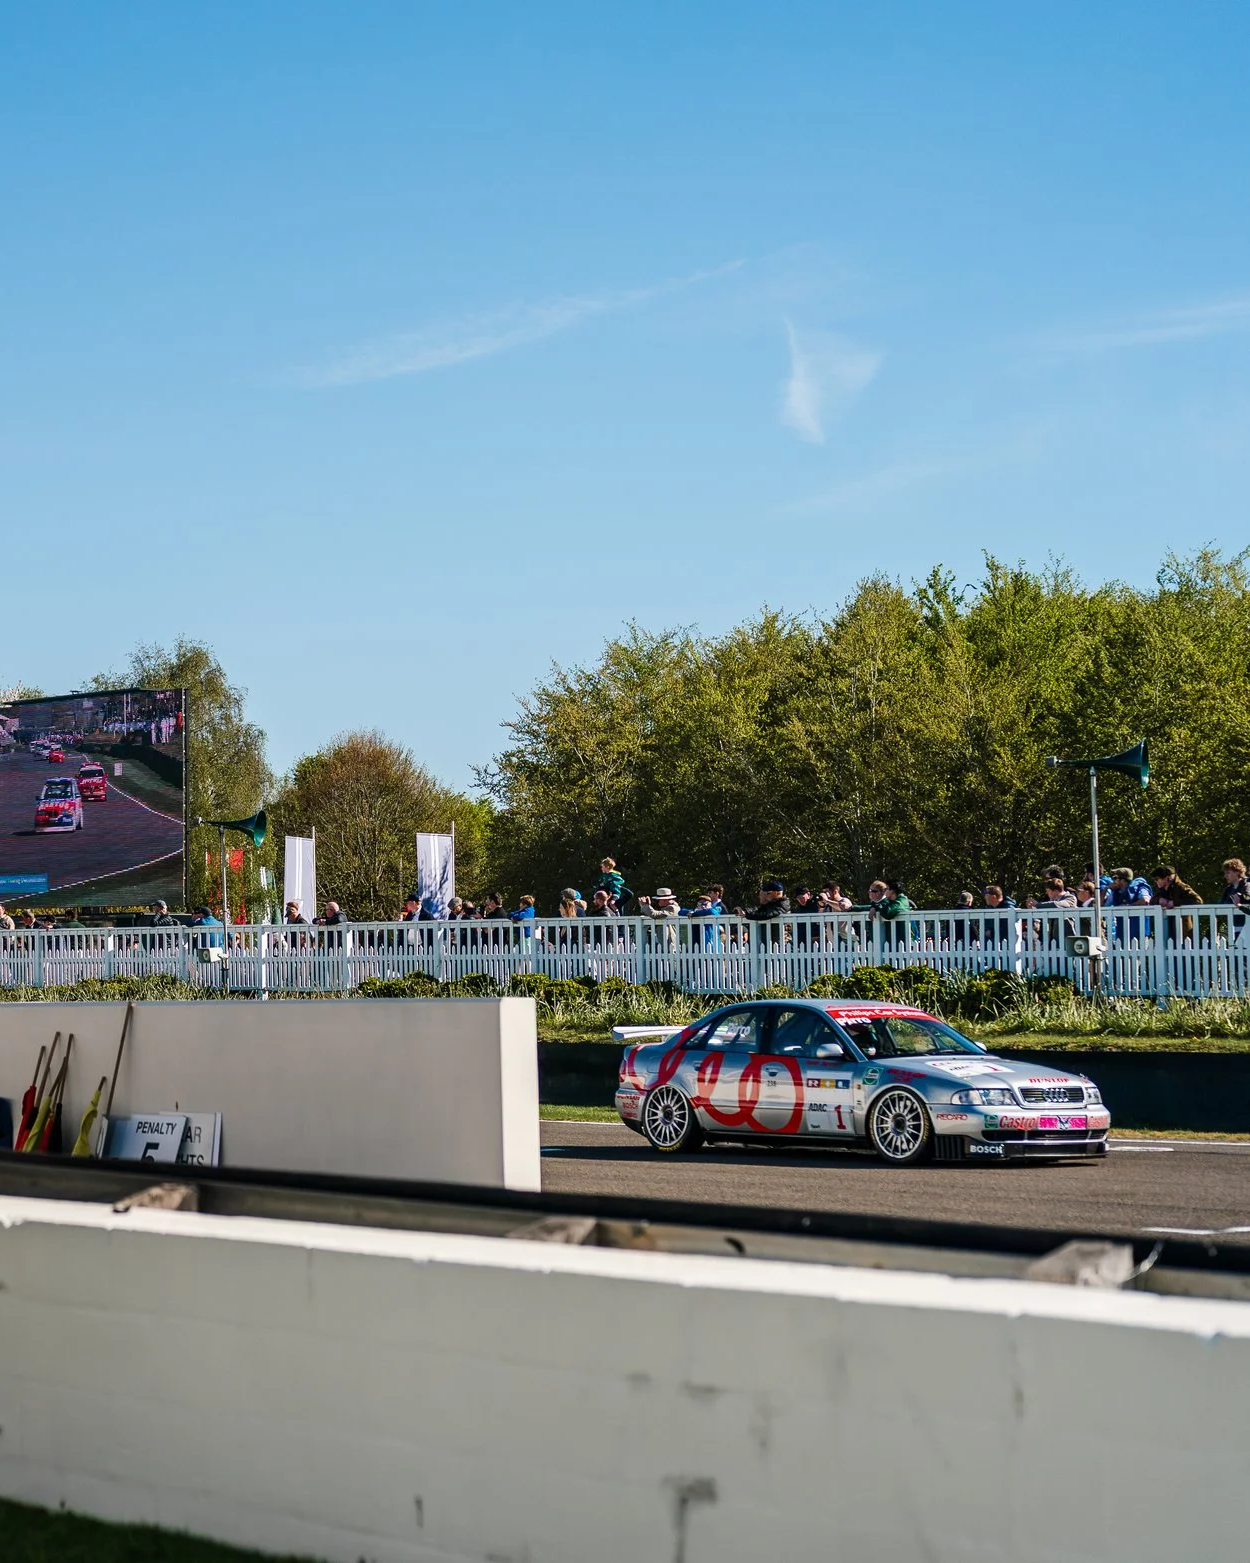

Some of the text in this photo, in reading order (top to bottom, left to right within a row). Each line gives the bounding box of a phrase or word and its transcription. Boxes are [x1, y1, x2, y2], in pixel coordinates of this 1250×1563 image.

[808, 1103, 847, 1130] ADAC 1
[936, 1113, 968, 1121] RECARO
[999, 1115, 1039, 1129] Castrol
[135, 1121, 177, 1136] PENALTY
[970, 1145, 1003, 1154] BOSCH
